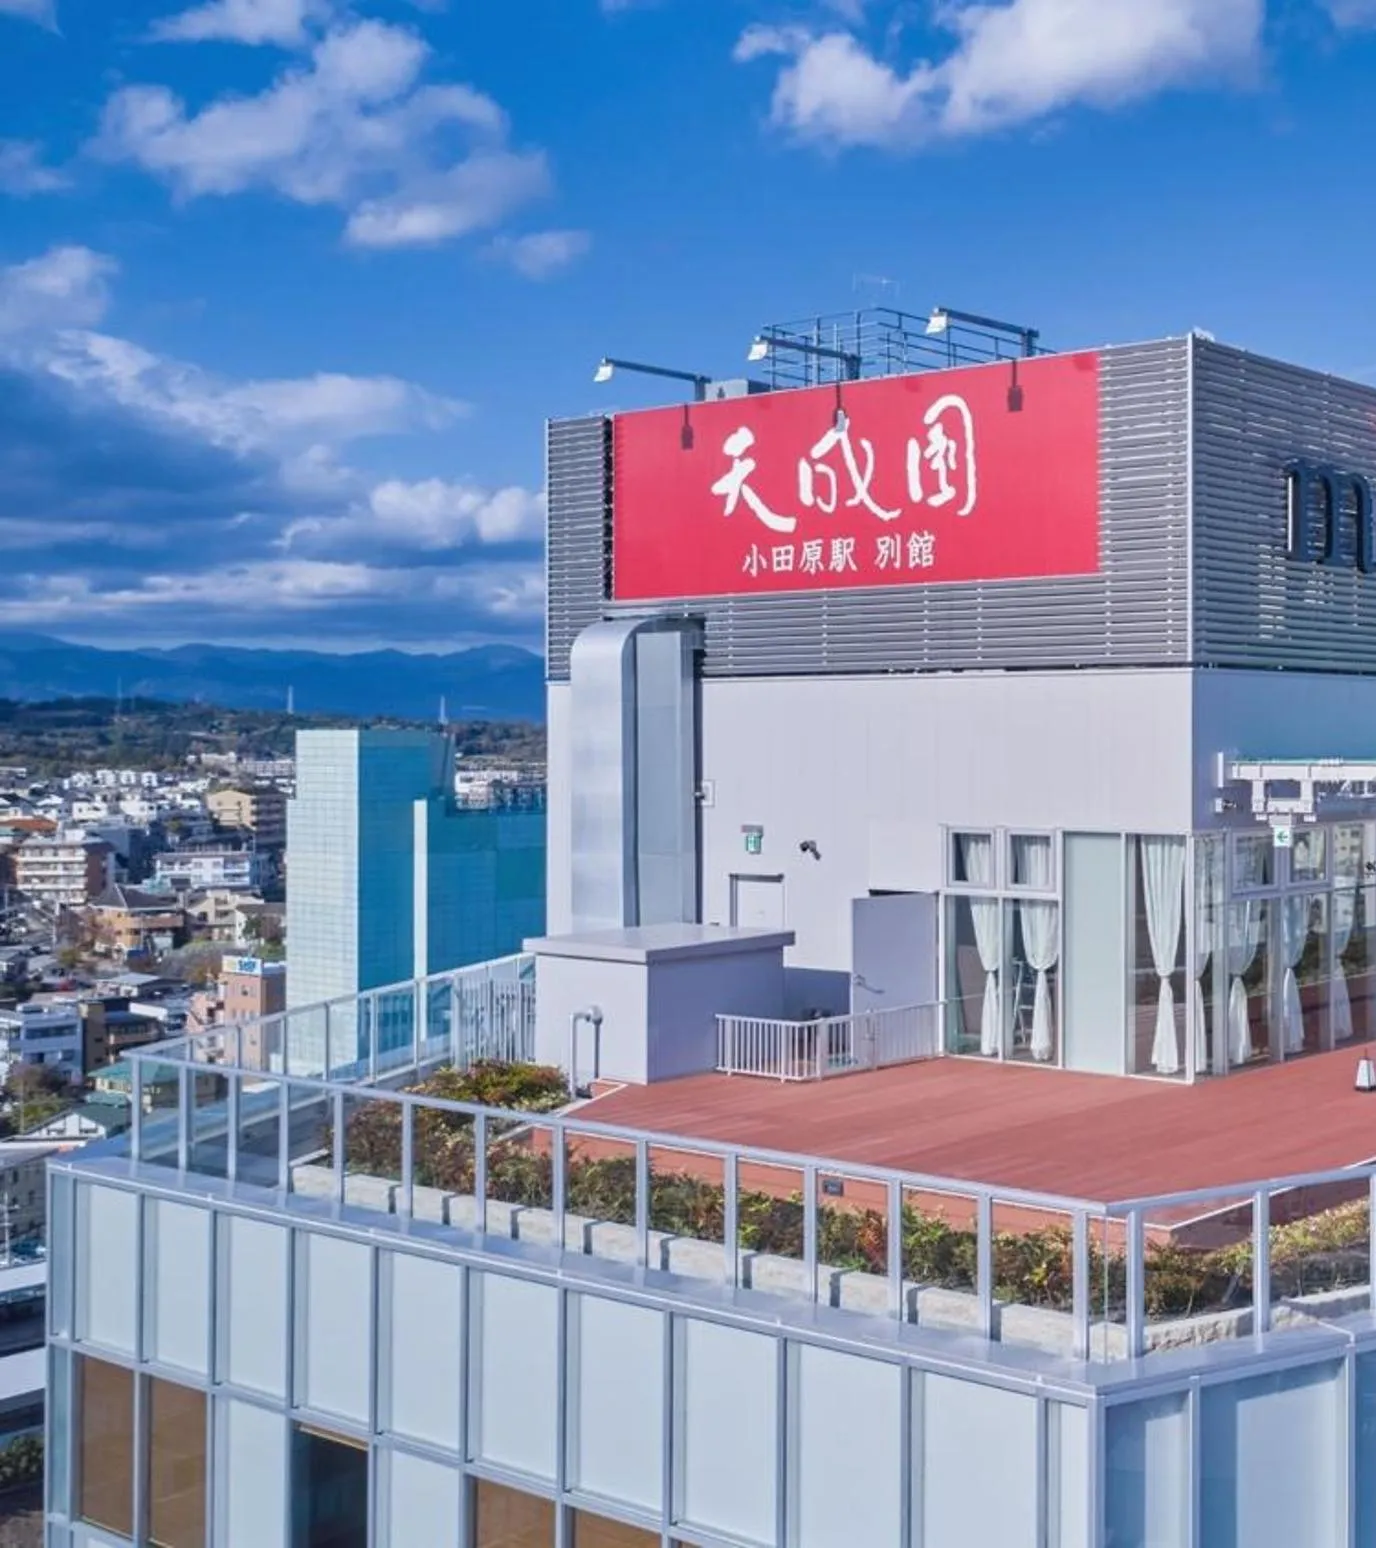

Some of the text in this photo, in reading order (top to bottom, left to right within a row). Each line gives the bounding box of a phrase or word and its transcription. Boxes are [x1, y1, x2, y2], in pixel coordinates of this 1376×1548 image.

[711, 395, 976, 533] 天成園
[742, 531, 935, 577] 小田原駅 別館
